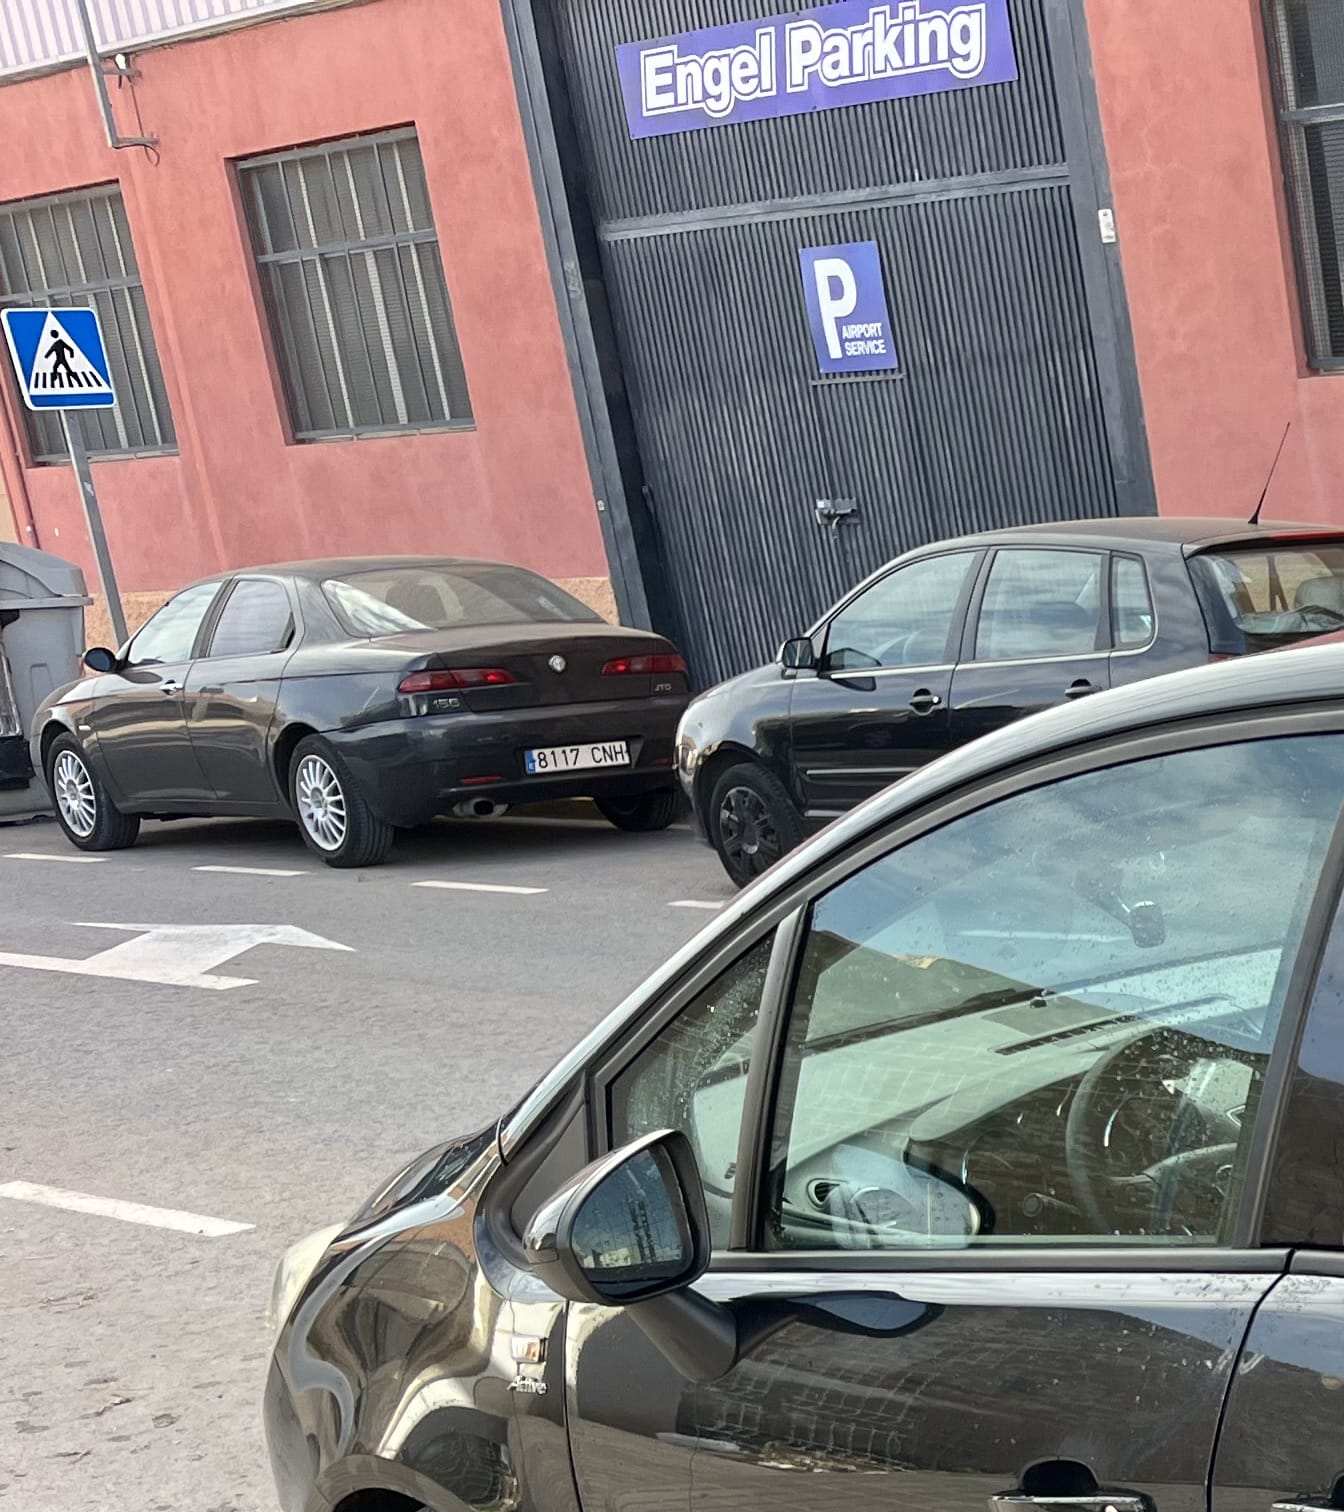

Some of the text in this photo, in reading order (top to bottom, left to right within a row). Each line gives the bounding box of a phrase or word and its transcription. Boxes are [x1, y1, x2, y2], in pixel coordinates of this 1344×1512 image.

[641, 1, 986, 118] Engel Parking
[813, 258, 857, 359] P
[842, 322, 882, 339] AIRPORT
[844, 339, 887, 356] SERVICE
[537, 743, 625, 769] 8117 CNH
